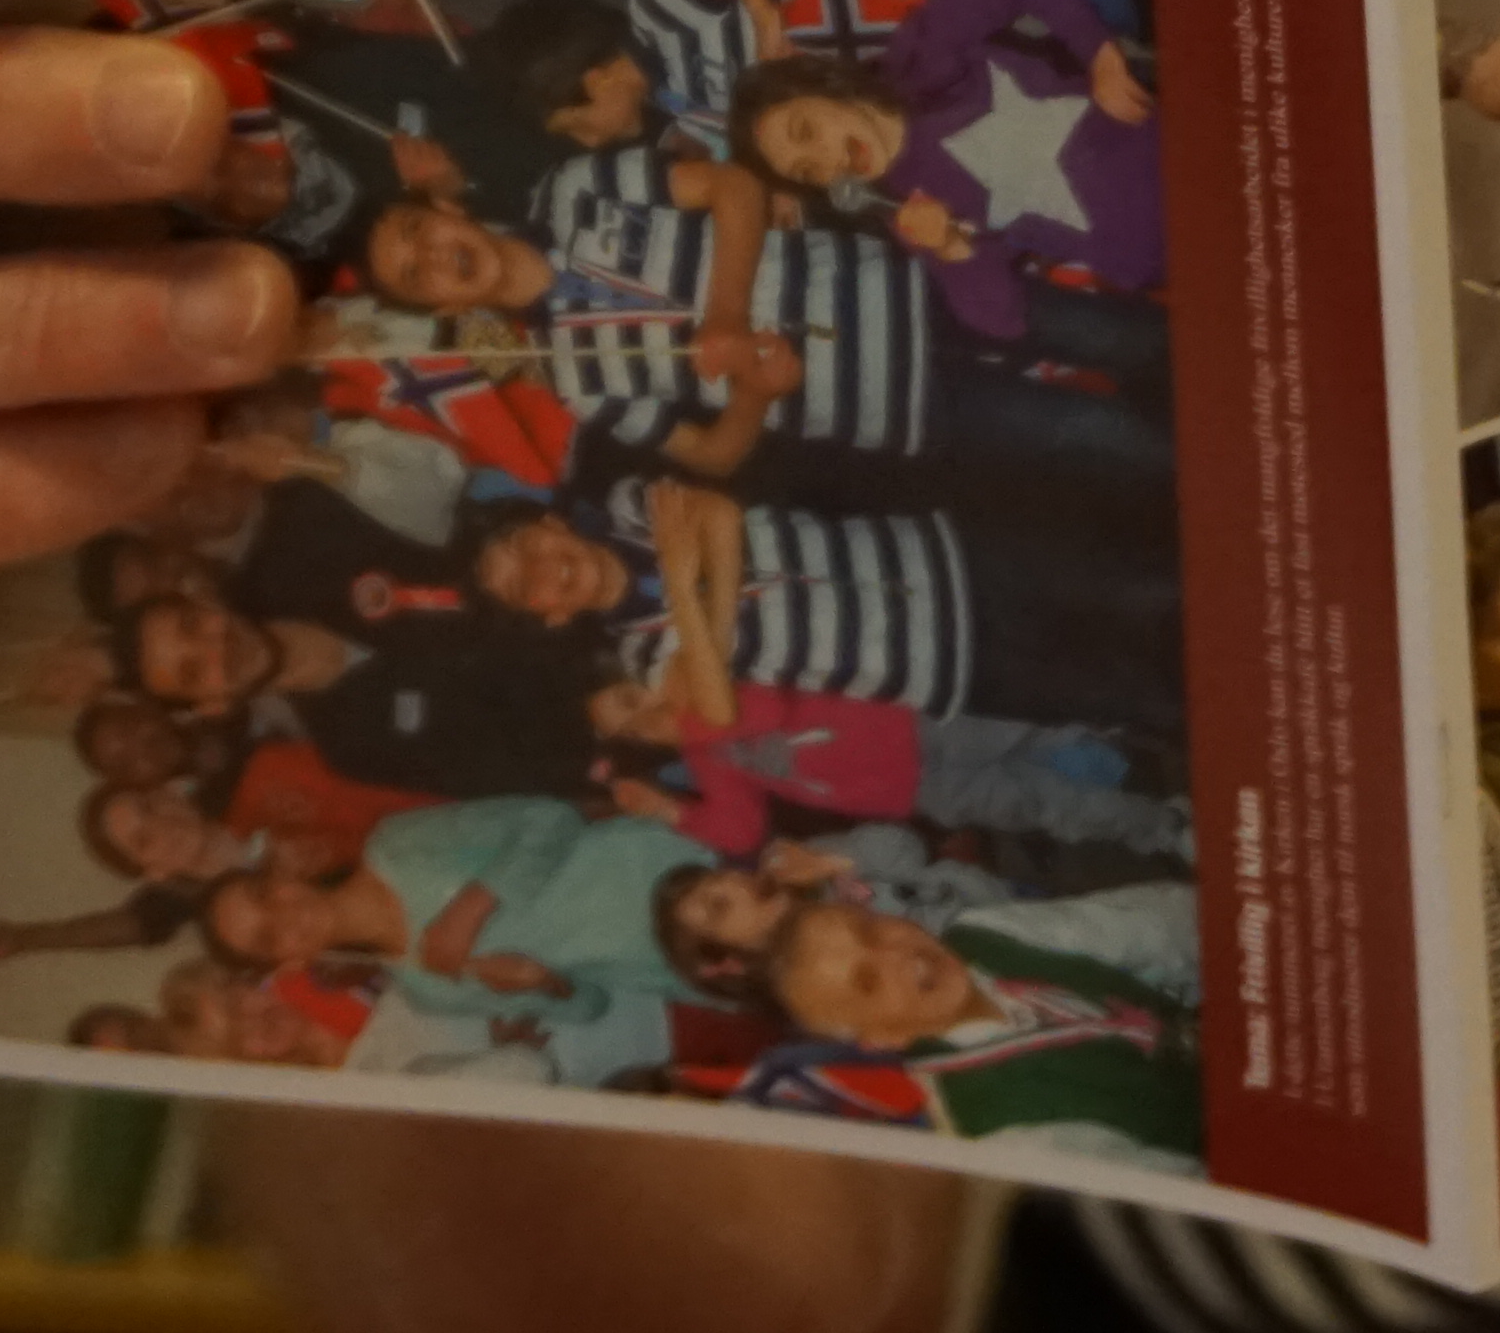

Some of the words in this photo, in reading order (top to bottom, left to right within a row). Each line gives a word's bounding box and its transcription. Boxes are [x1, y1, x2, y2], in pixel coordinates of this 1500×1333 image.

[1234, 108, 1258, 117] i
[1264, 89, 1289, 150] ulike
[1268, 157, 1291, 188] fra
[1273, 193, 1299, 322] mennesker
[1257, 510, 1280, 544] det
[1264, 551, 1281, 587] om
[1263, 645, 1284, 673] du
[1265, 679, 1287, 720] kan
[1267, 725, 1291, 777] Oslo
[1234, 787, 1262, 879] kirken
[1273, 798, 1294, 874] Kirken
[1234, 883, 1264, 895] i
[1238, 901, 1270, 1004] Frivillig
[1242, 1009, 1270, 1088] Tema:
